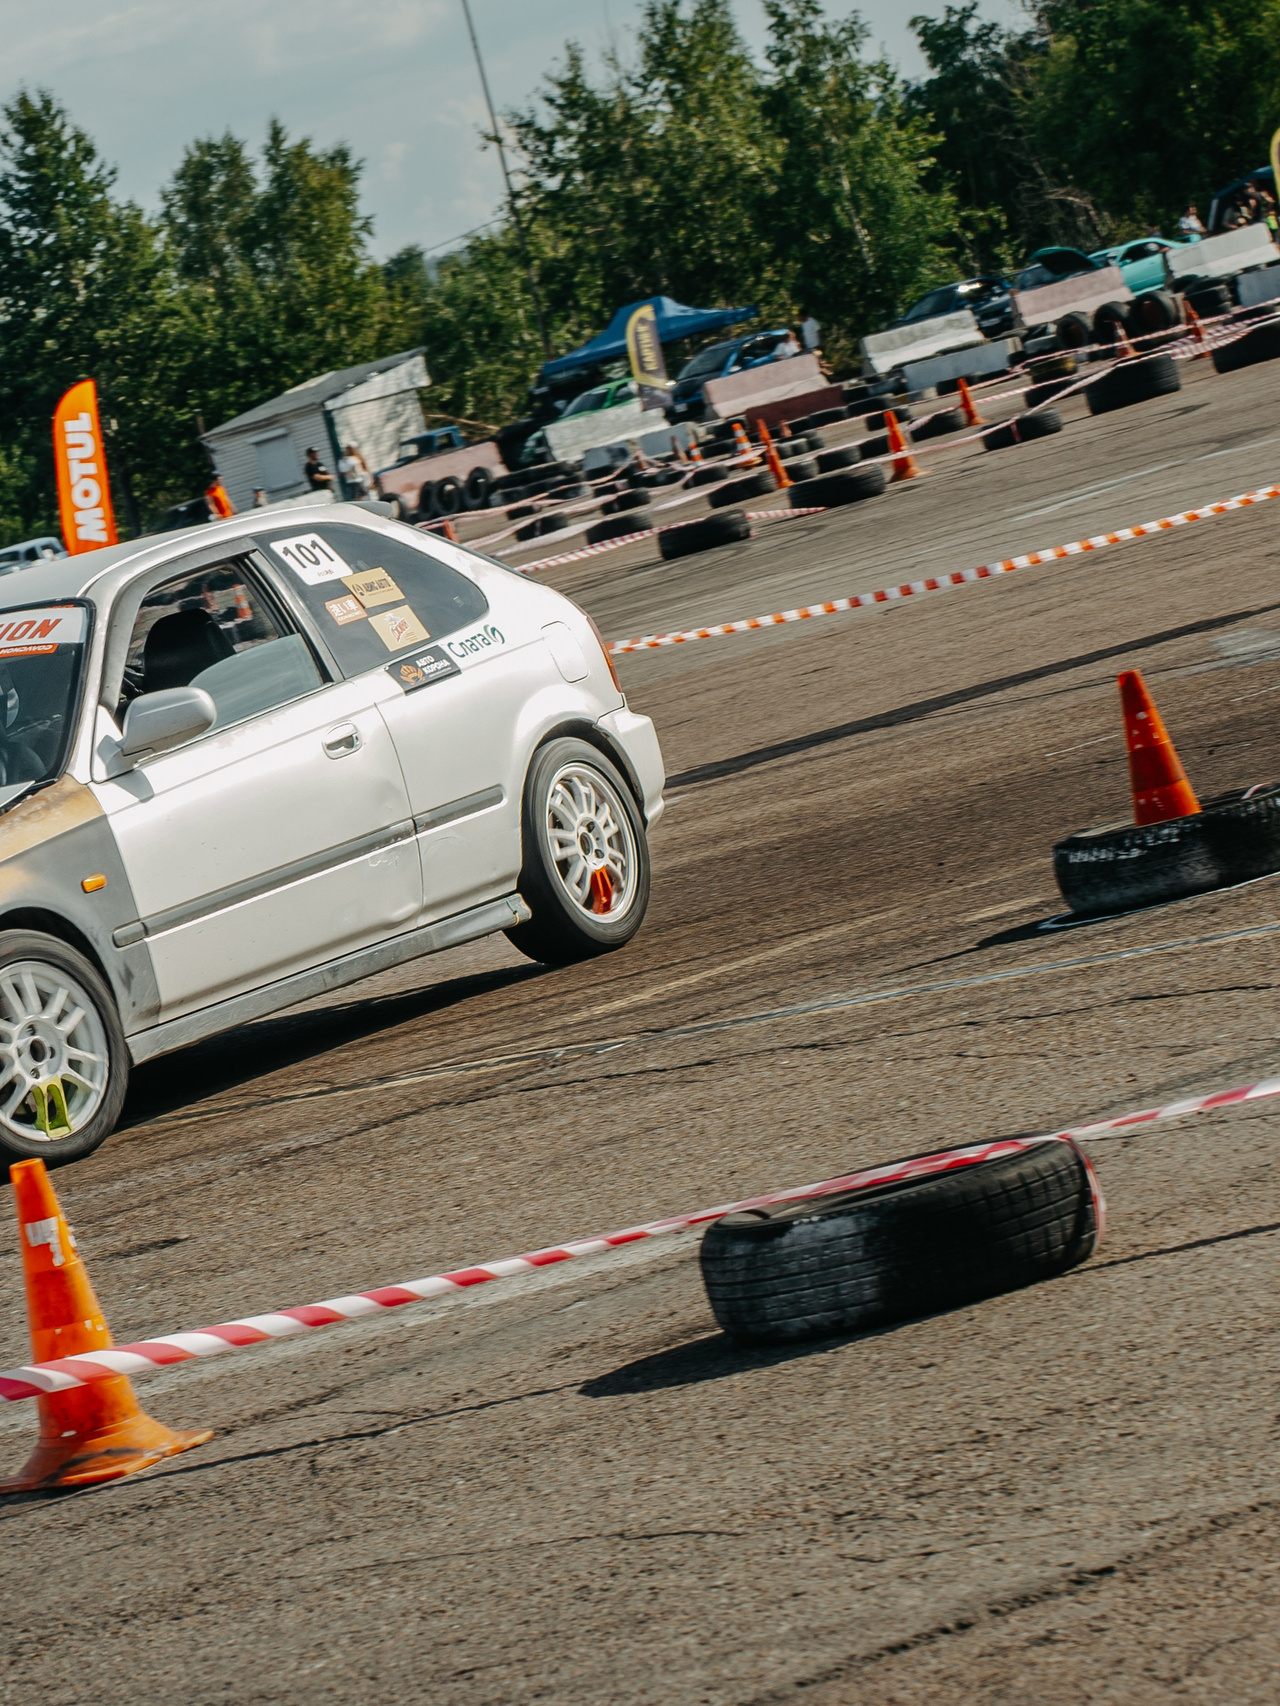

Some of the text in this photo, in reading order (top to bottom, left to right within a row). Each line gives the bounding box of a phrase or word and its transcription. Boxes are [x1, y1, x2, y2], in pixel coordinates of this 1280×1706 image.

[64, 412, 108, 543] MOTUL
[282, 539, 335, 570] 101
[447, 633, 492, 659] Слата
[416, 655, 435, 668] АВТО
[422, 658, 451, 675] КОРОНА
